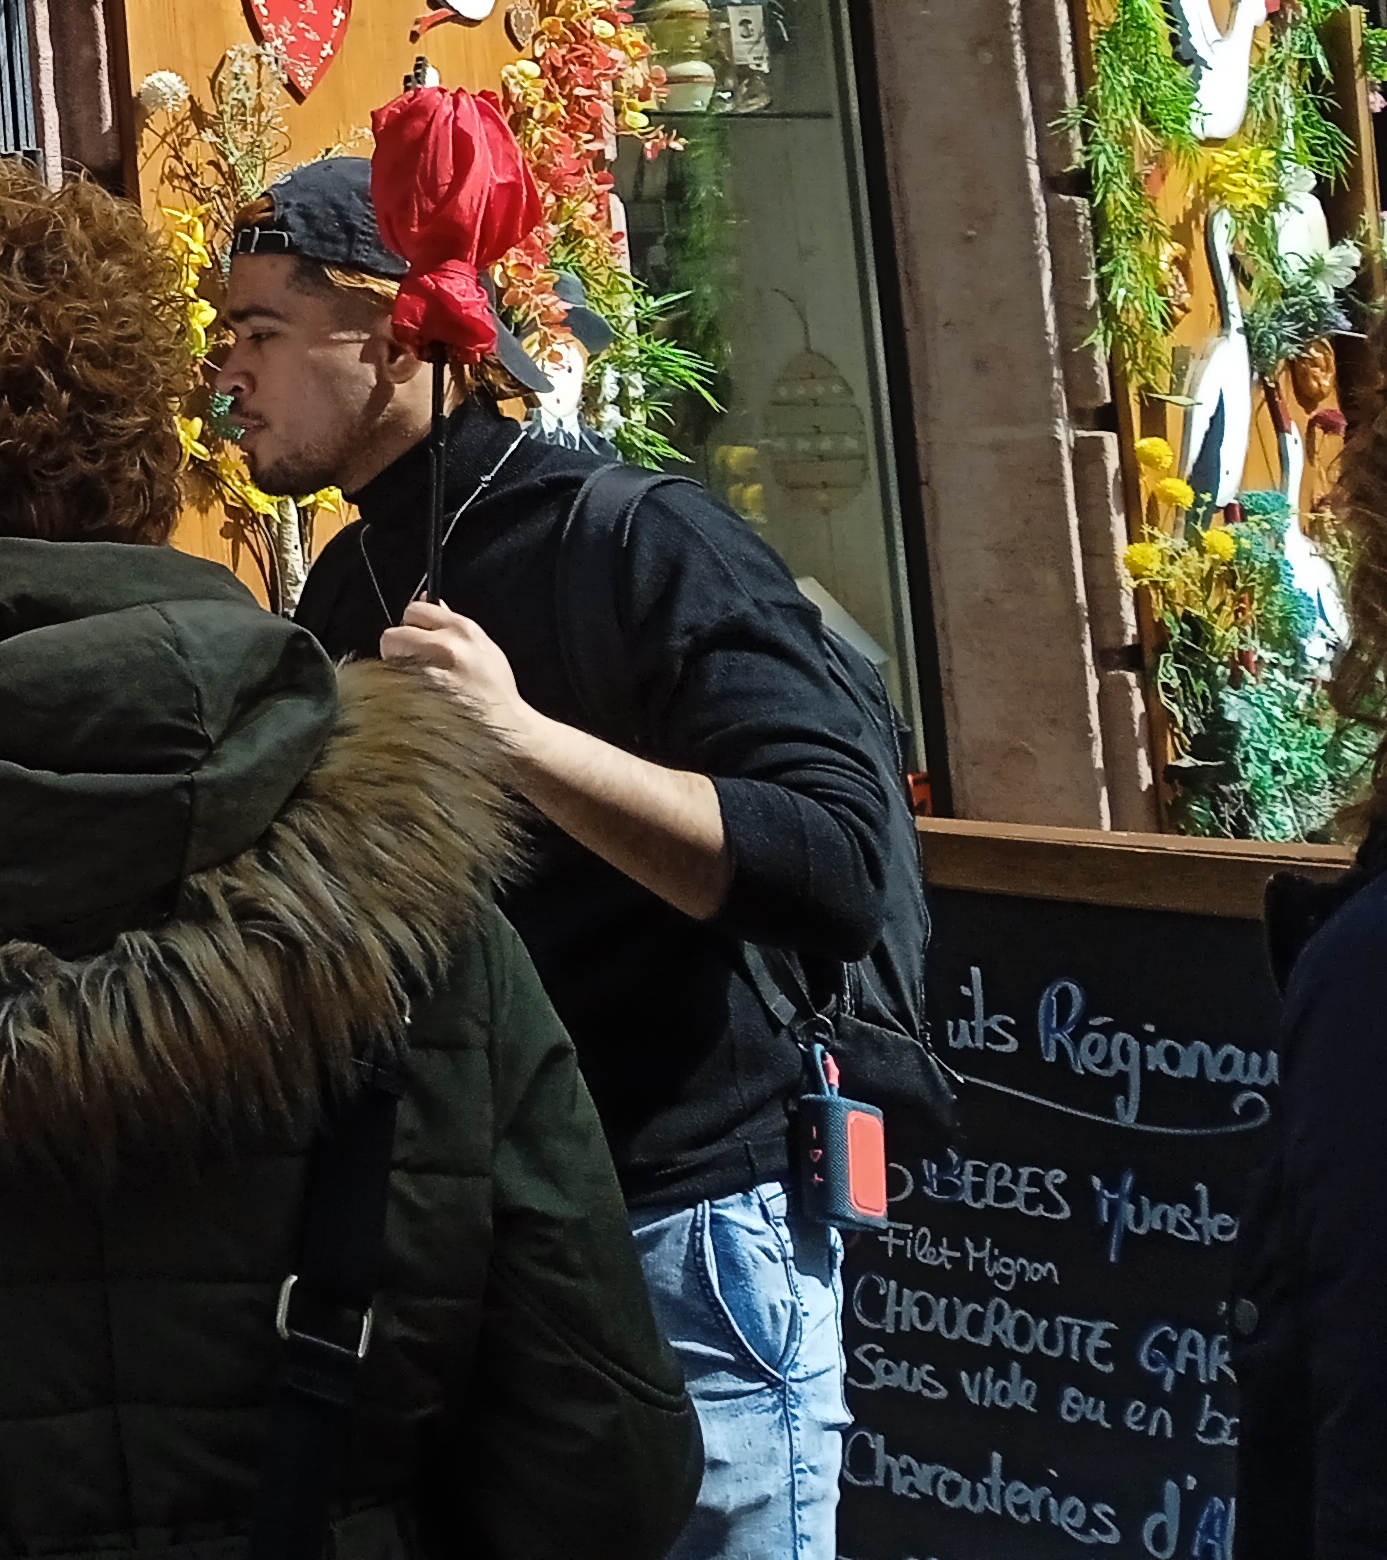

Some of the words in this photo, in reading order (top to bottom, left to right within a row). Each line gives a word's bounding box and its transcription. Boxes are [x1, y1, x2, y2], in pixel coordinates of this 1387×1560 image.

[1038, 978, 1281, 1125] Régionau
[877, 1221, 962, 1271] Filet
[964, 1236, 1061, 1292] Mignon
[1090, 1168, 1239, 1263] Munste
[853, 1270, 1120, 1373] CHOUCROUTE
[1138, 1325, 1239, 1395] GAR
[847, 1343, 949, 1400] Sous
[960, 1361, 1038, 1414] vide
[1060, 1386, 1113, 1430] ou
[1124, 1400, 1174, 1439] en
